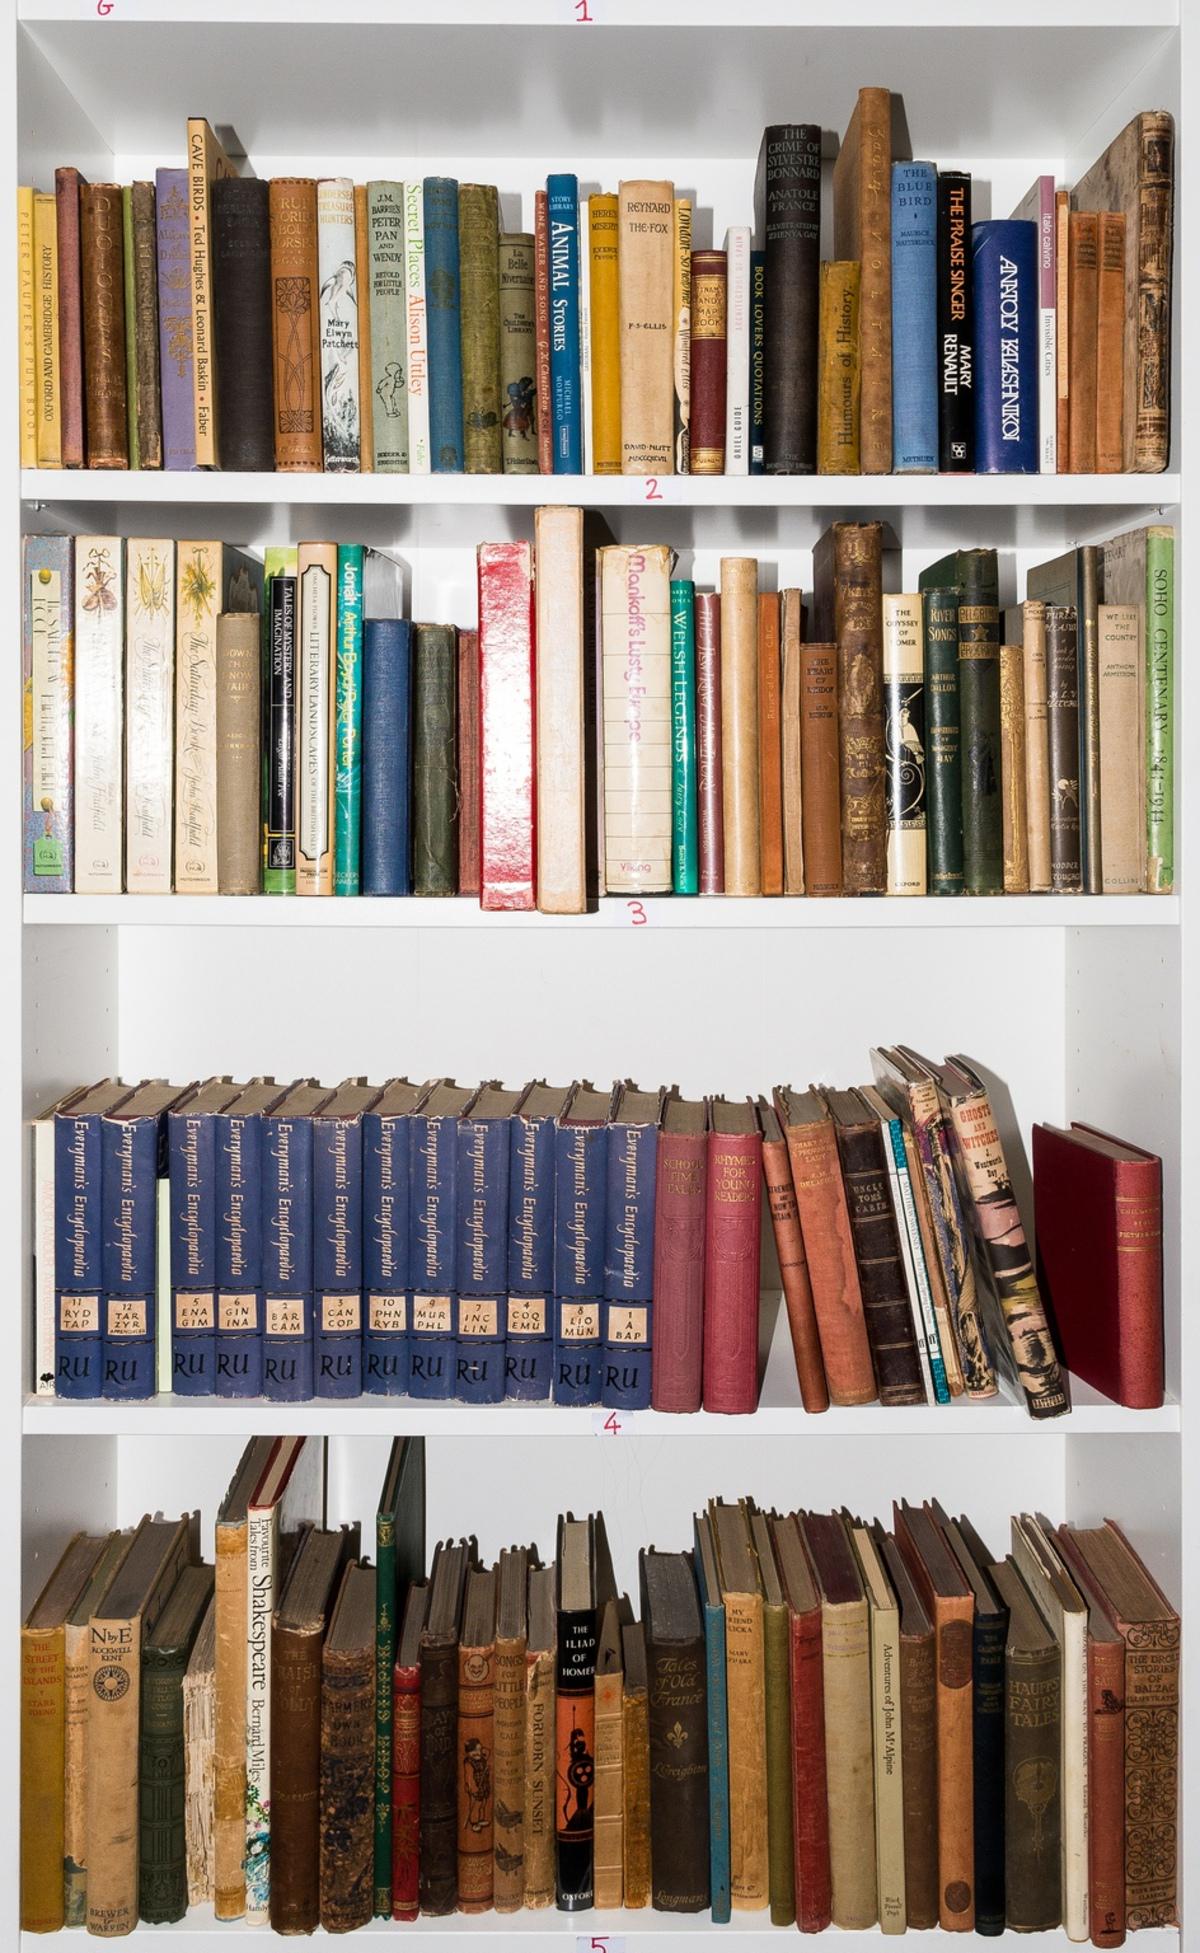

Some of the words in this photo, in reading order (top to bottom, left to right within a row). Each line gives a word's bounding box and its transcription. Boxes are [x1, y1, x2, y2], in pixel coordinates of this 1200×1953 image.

[575, 0, 593, 21] 1
[782, 127, 807, 140] THE
[191, 134, 204, 170] CAVE
[768, 142, 804, 154] CRIME
[806, 142, 820, 153] OF
[767, 154, 820, 168] SYLVESTRE
[767, 166, 820, 180] BONNARD
[903, 168, 928, 178] THE
[192, 175, 205, 212] BIRDS
[768, 188, 819, 202] ANATOLE
[896, 181, 933, 192] BLUE
[407, 185, 423, 233] Secret
[627, 202, 671, 214] REYNARD
[772, 200, 816, 213] FRANCE
[898, 195, 932, 208] BIRD
[950, 187, 964, 217] THE
[371, 217, 401, 229] PETER
[1043, 212, 1051, 231] italo
[20, 212, 30, 258] PETER
[194, 224, 206, 246] Ted
[375, 231, 398, 241] PAN
[950, 218, 964, 267] PRAISE
[373, 253, 402, 264] WENDY
[538, 232, 547, 265] WATER
[551, 221, 570, 292] ANIMAL
[1043, 234, 1052, 270] calvino
[42, 244, 52, 290] HISTORY
[193, 249, 207, 290] Hughes
[408, 238, 424, 287] Places
[375, 272, 400, 280] RETOLD
[538, 272, 548, 292] AND
[754, 265, 764, 299] BOOK
[196, 294, 206, 305] &
[375, 288, 400, 297] PEOPLE
[952, 268, 965, 321] SINGER
[1000, 255, 1019, 333] ANATOLY
[409, 294, 424, 345] Alison
[539, 295, 548, 322] SONG
[43, 295, 53, 356] CAMBRIDGE
[195, 309, 208, 354] Leonard
[325, 329, 353, 339] Elwyn
[327, 319, 350, 332] Mary
[553, 299, 569, 352] STORIES
[754, 303, 764, 350] LOVERS
[1044, 315, 1053, 349] Invisible
[322, 338, 360, 350] Patchett
[44, 357, 53, 379] AND
[836, 351, 851, 367] of
[944, 333, 958, 395] RENAULT
[960, 345, 972, 389] MARY
[1044, 351, 1053, 376] Cities
[25, 357, 34, 386] PUN
[197, 358, 209, 392] Baskin
[409, 349, 426, 396] Uttley
[44, 379, 54, 422] OXFORD
[556, 375, 564, 421] MORPURGO
[564, 378, 572, 416] MICHAEL
[753, 352, 763, 426] QUOTATIONS
[26, 397, 35, 441] BOOK
[198, 406, 210, 437] Faber
[837, 376, 854, 446] Humours
[646, 479, 662, 500] 2
[344, 562, 359, 606] Jonah
[628, 554, 647, 637] Mankoff's
[1152, 568, 1168, 617] SOHO
[283, 586, 294, 616] TALES
[896, 609, 912, 617] THE
[284, 616, 294, 630] OF
[930, 608, 956, 623] RIVER
[273, 608, 283, 676] IMAGINATION
[673, 610, 688, 675] WELSH
[928, 626, 958, 642] SONGS
[284, 630, 294, 674] MYSTERY
[309, 631, 320, 691] LITERARY
[624, 640, 646, 683] Lusty
[187, 655, 209, 716] Saturday
[285, 675, 294, 698] AND
[1150, 628, 1168, 735] CENTENARY
[674, 680, 689, 763] LEGENDS
[188, 719, 210, 752] Book
[309, 694, 321, 776] LANDSCAPES
[627, 901, 647, 925] 3
[959, 1102, 992, 1124] GHOSTS
[973, 1121, 987, 1133] AND
[962, 1128, 1000, 1151] WITCHES
[67, 1120, 90, 1190] Everyman's
[179, 1119, 202, 1189] Everyman's
[224, 1119, 246, 1189] Everyman's
[374, 1120, 396, 1190] Everyman's
[619, 1129, 642, 1200] Everyman's
[714, 1178, 755, 1190] YOUNG
[721, 1167, 747, 1178] FOR
[986, 1169, 999, 1178] Day
[853, 1181, 884, 1193] UNCLE
[66, 1195, 90, 1278] Encyclopaedia
[179, 1193, 207, 1276] Encyclopaedia
[223, 1193, 247, 1276] Encyclopaedia
[373, 1194, 395, 1278] Encyclopaedia
[616, 1204, 639, 1288] Encyclopaedia
[64, 1309, 92, 1318] RYD
[181, 1309, 208, 1317] ENA
[192, 1297, 200, 1306] 5
[225, 1307, 249, 1316] GIN
[233, 1298, 241, 1306] 6
[382, 1299, 395, 1307] 10
[64, 1319, 89, 1329] TAP
[181, 1319, 209, 1328] GIM
[226, 1318, 249, 1327] INA
[374, 1320, 400, 1329] RYB
[375, 1310, 402, 1318] PHN
[625, 1321, 633, 1330] A
[628, 1311, 633, 1319] 1
[616, 1331, 642, 1340] BAP
[58, 1355, 90, 1381] RU
[174, 1353, 204, 1378] RU
[217, 1353, 249, 1378] RU
[368, 1354, 397, 1378] RU
[605, 1365, 640, 1392] RU
[604, 1411, 622, 1435] 4
[250, 1517, 261, 1544] Tales
[260, 1518, 272, 1568] Favourite
[249, 1544, 261, 1571] from
[91, 1627, 107, 1645] N
[107, 1631, 119, 1645] by
[119, 1626, 133, 1644] E
[247, 1574, 272, 1691] Shakespeare
[573, 1626, 588, 1634] THE
[91, 1646, 132, 1655] ROCKWELL
[566, 1638, 596, 1649] ILIAD
[24, 1654, 60, 1665] STREET
[572, 1653, 587, 1662] OF
[656, 1656, 698, 1673] Tales
[883, 1643, 893, 1694] Adventures
[23, 1675, 63, 1687] ISLANDS
[670, 1672, 698, 1689] Old
[1134, 1665, 1177, 1676] STORIES
[1147, 1674, 1163, 1684] OF
[651, 1688, 705, 1708] France
[884, 1695, 894, 1705] of
[1134, 1684, 1176, 1695] BALZAC
[1008, 1695, 1059, 1712] FAIRY
[251, 1698, 265, 1747] Bernard
[882, 1707, 895, 1729] John
[1009, 1711, 1060, 1729] TALES
[532, 1703, 545, 1773] FORLORN
[249, 1749, 264, 1783] Miles
[532, 1780, 544, 1836] SUNSET
[90, 1908, 130, 1919] BREWER
[89, 1922, 130, 1934] WARREN
[592, 1936, 610, 1953] 5
